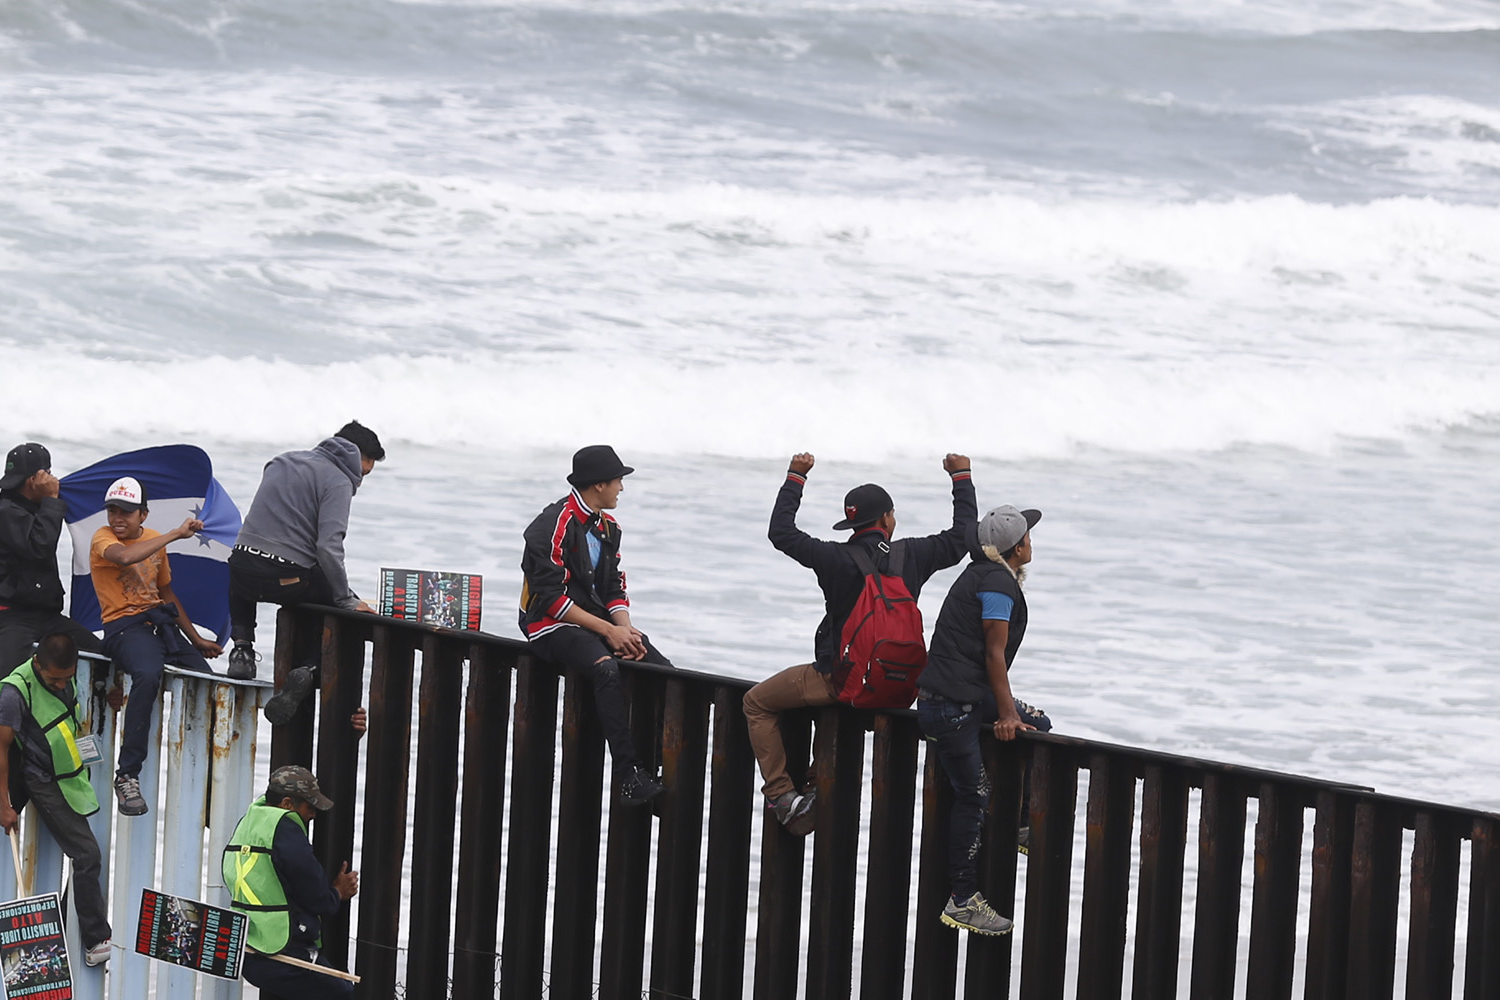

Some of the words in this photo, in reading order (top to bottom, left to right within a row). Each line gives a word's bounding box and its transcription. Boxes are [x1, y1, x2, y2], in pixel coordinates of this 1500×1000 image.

[109, 490, 136, 499] QUEEN
[405, 573, 418, 614] TRANSITO
[11, 912, 43, 929] ALTO
[21, 921, 60, 941] TRANSITO
[137, 891, 157, 954] MIGRANTES
[149, 894, 164, 956] CENTROAMERICANOS
[206, 909, 221, 932] LIBRE
[0, 928, 21, 945] LIBRE
[200, 931, 218, 970] TRANSITO
[215, 926, 231, 960] ALTO
[224, 915, 242, 977] DEPORTACIONES
[8, 980, 71, 998] CENTROAMERICANOS
